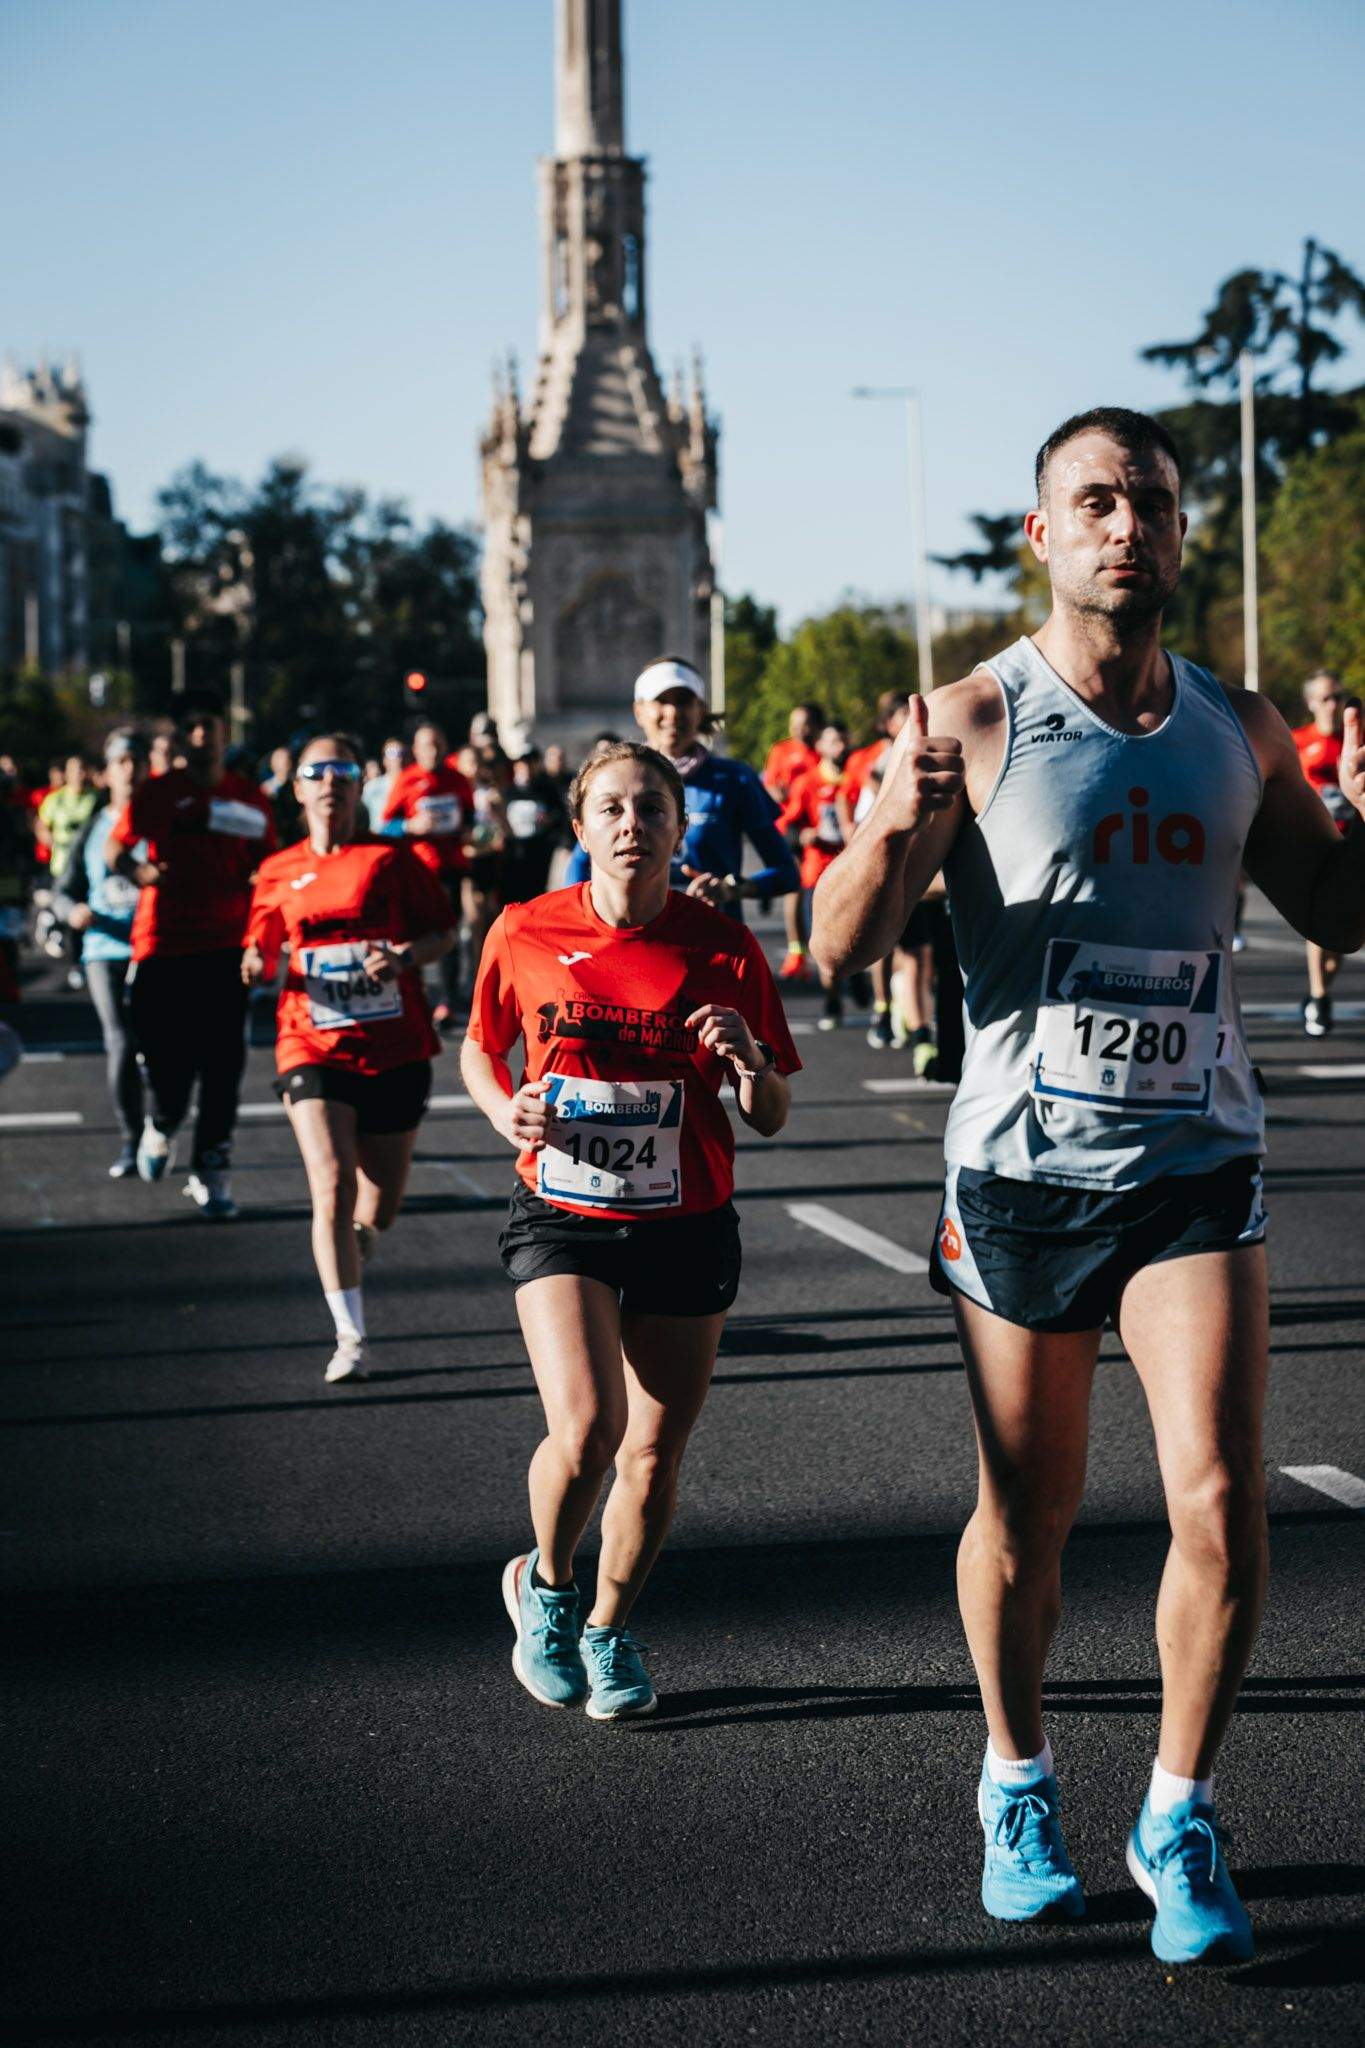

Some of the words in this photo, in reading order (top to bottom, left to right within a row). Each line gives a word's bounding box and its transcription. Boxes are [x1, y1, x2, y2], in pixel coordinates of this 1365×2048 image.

[1031, 731, 1083, 743] VIATOR
[1093, 787, 1206, 866] ria
[1103, 973, 1191, 991] BOMBEROS
[618, 1025, 636, 1043] de
[1074, 1015, 1188, 1065] 1280
[584, 1100, 659, 1115] BOMBEROS
[565, 1132, 658, 1172] 1024
